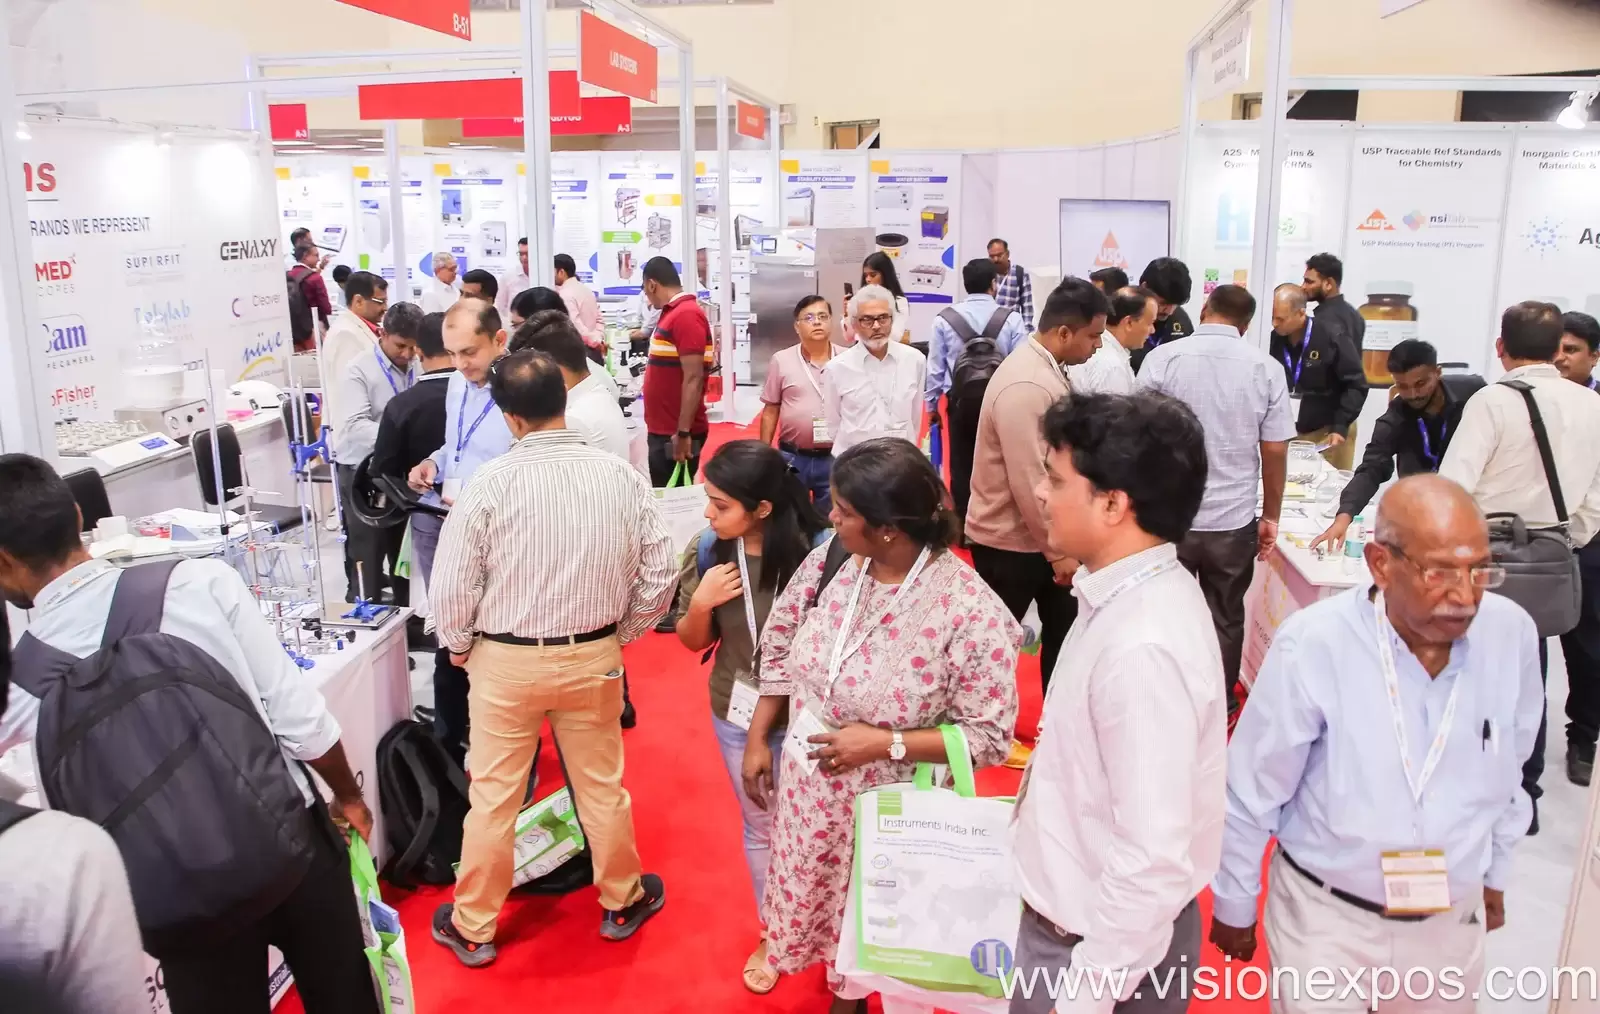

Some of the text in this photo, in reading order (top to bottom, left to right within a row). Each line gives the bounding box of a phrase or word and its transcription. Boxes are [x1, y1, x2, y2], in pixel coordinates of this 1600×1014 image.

[453, 13, 470, 37] B-51
[617, 124, 630, 133] A-3
[1222, 149, 1242, 157] A2S
[1362, 147, 1502, 157] USP Traceable Ref Standards
[1522, 149, 1570, 159] Inorganic
[1399, 159, 1463, 170] for Chemistry
[1538, 162, 1586, 170] Materials
[72, 218, 90, 235] WE
[93, 216, 150, 233] REPRESENT
[220, 238, 277, 261] GENAXY
[1377, 240, 1415, 248] Proficiency
[1416, 241, 1440, 249] Testing
[35, 260, 72, 282] MED
[883, 817, 991, 838] Instruments India Inc.
